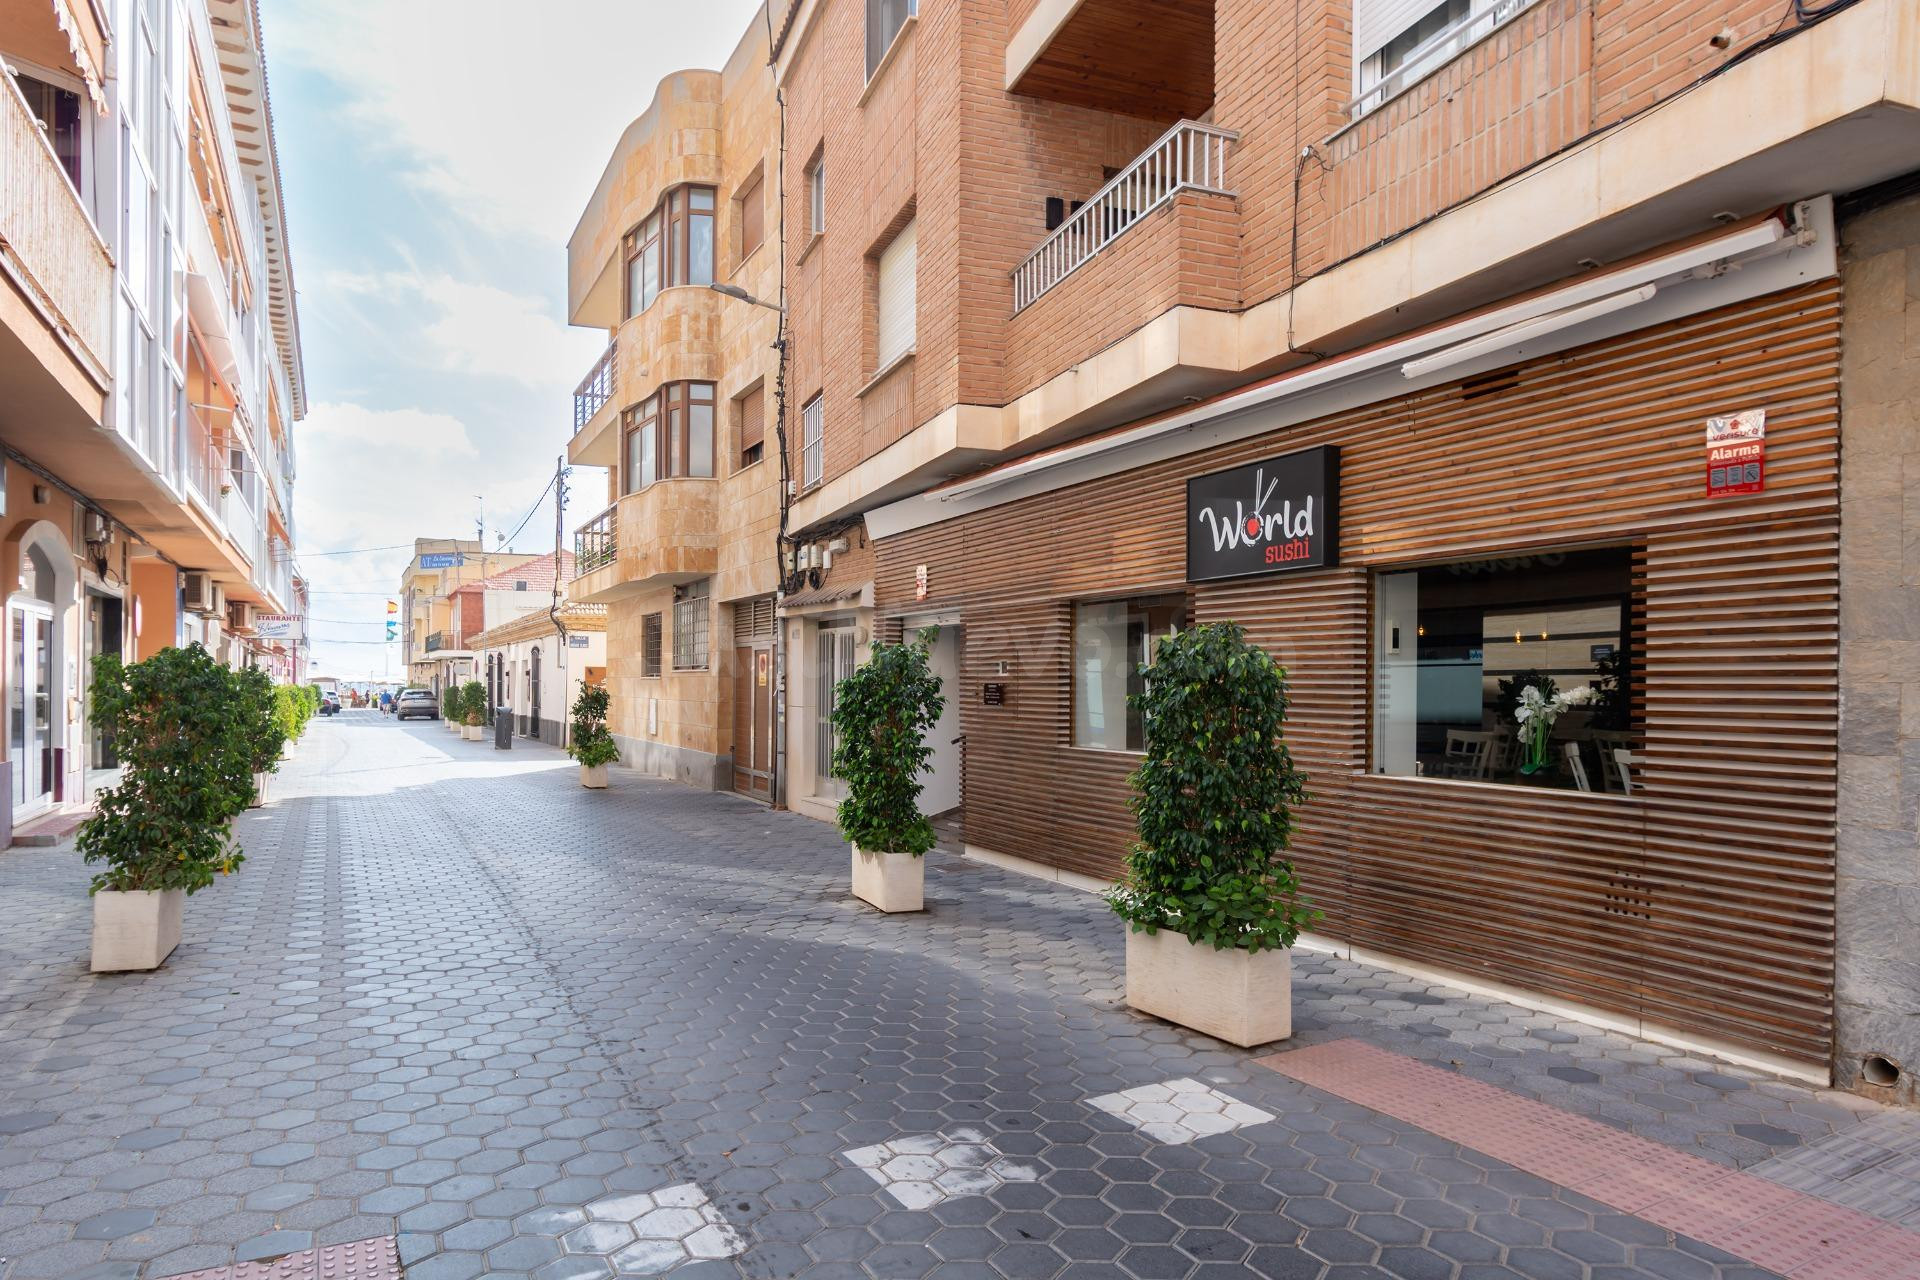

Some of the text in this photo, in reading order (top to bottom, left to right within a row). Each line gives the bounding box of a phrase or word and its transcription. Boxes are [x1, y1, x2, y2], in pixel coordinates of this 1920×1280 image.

[1710, 444, 1760, 460] Alarma
[1199, 494, 1313, 551] World
[1265, 537, 1310, 564] sushi
